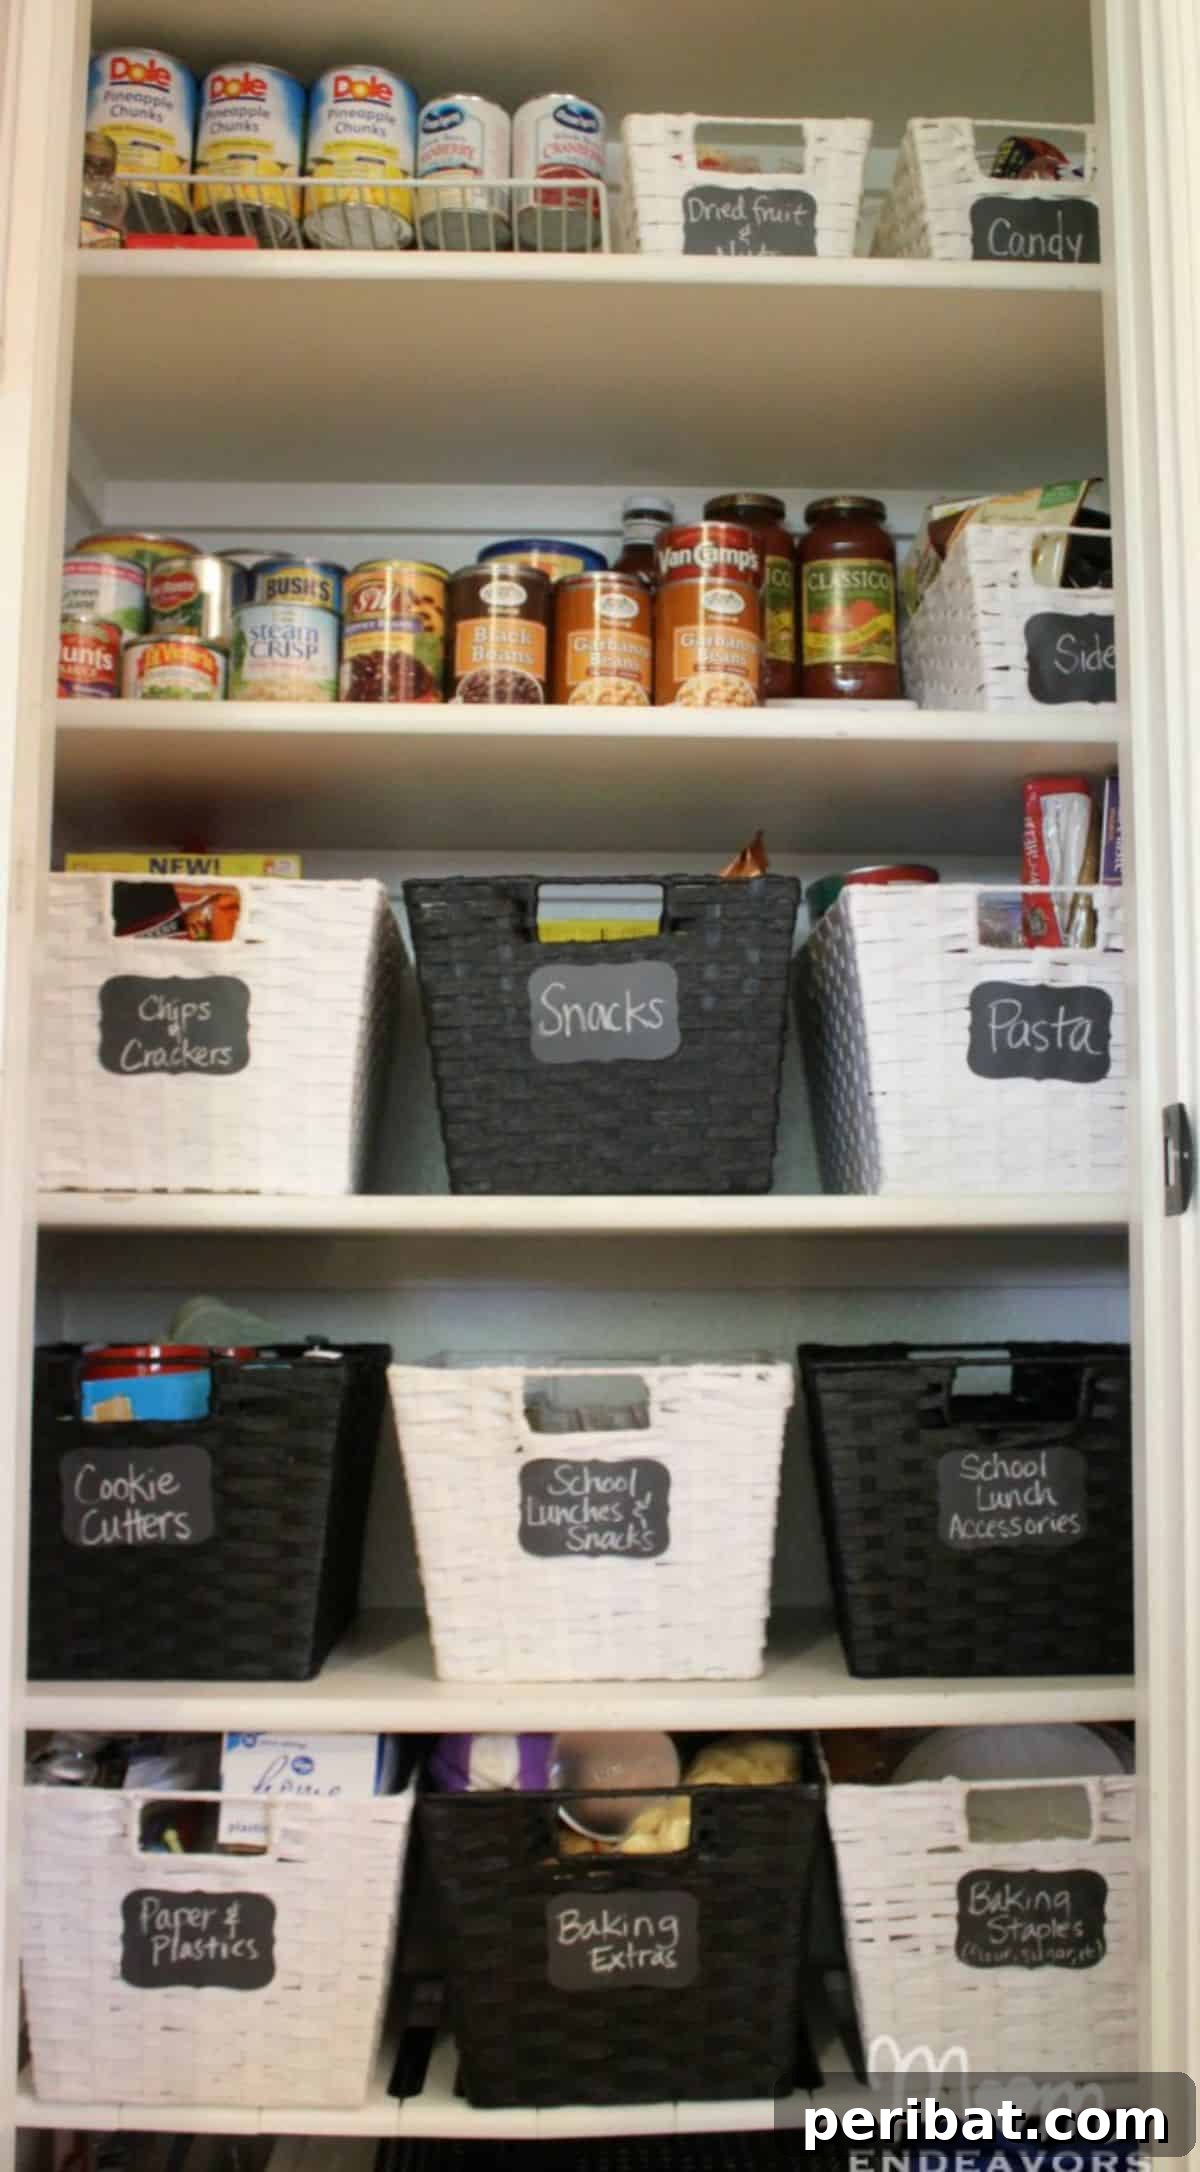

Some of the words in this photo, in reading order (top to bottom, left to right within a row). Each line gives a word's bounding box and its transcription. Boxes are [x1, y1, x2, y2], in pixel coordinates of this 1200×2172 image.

[110, 56, 171, 86] Dole
[210, 72, 267, 98] Dole
[104, 89, 173, 110] Pineapple
[334, 75, 392, 101] Dole
[109, 103, 163, 123] Chunks
[328, 108, 396, 126] Pineapple
[209, 119, 259, 136] Chunks
[334, 121, 386, 137] Chunks
[687, 196, 746, 223] Dried
[987, 210, 1084, 262] Candy
[266, 577, 331, 603] BUSH'S
[808, 569, 889, 591] CLASSICO
[250, 623, 319, 642] steam
[473, 625, 533, 646] Black
[250, 640, 320, 660] CRISP
[471, 645, 535, 665] Beans
[589, 652, 640, 671] Beans
[701, 648, 748, 667] Beans
[149, 857, 221, 875] NEW!
[137, 994, 212, 1028] Chips
[539, 981, 665, 1038] Snacks
[987, 998, 1103, 1055] Pasta
[120, 1037, 233, 1071] Crackers
[547, 1463, 637, 1497] School
[959, 1451, 1047, 1481] School
[74, 1463, 181, 1504] Cookie
[975, 1479, 1059, 1512] Lunch
[527, 1496, 624, 1526] Lunches
[80, 1508, 193, 1545] Cutters
[565, 1523, 656, 1551] Snacks
[948, 1512, 1081, 1540] Accessories
[967, 1879, 1072, 1918] Baking
[139, 1896, 218, 1935] Paper
[557, 1909, 679, 1949] Baking
[986, 1914, 1084, 1950] Staples
[151, 1933, 260, 1966] Plastics
[588, 1941, 678, 1973] Extras
